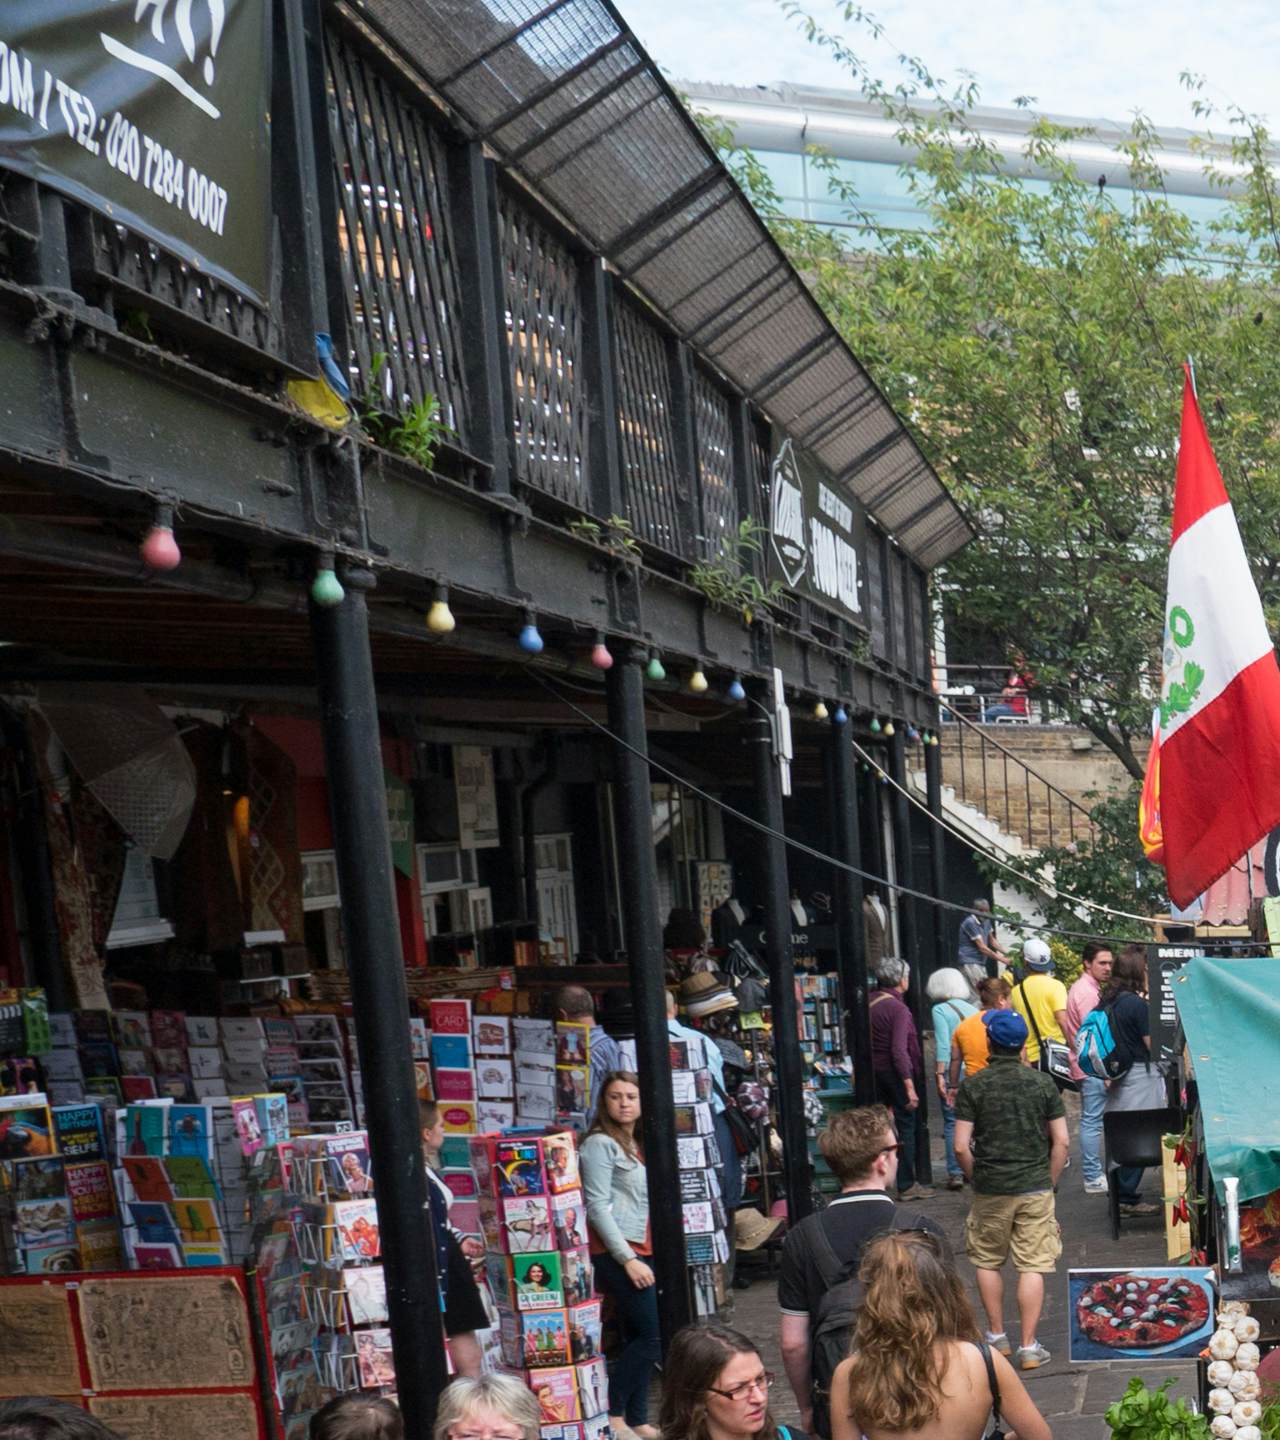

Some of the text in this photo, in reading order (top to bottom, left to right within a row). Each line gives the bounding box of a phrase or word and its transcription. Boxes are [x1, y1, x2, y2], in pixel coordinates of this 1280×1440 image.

[56, 79, 105, 156] TEL:
[106, 112, 140, 182] 020
[143, 135, 184, 210] 7284
[188, 168, 227, 236] 0007
[1158, 948, 1205, 958] MENU
